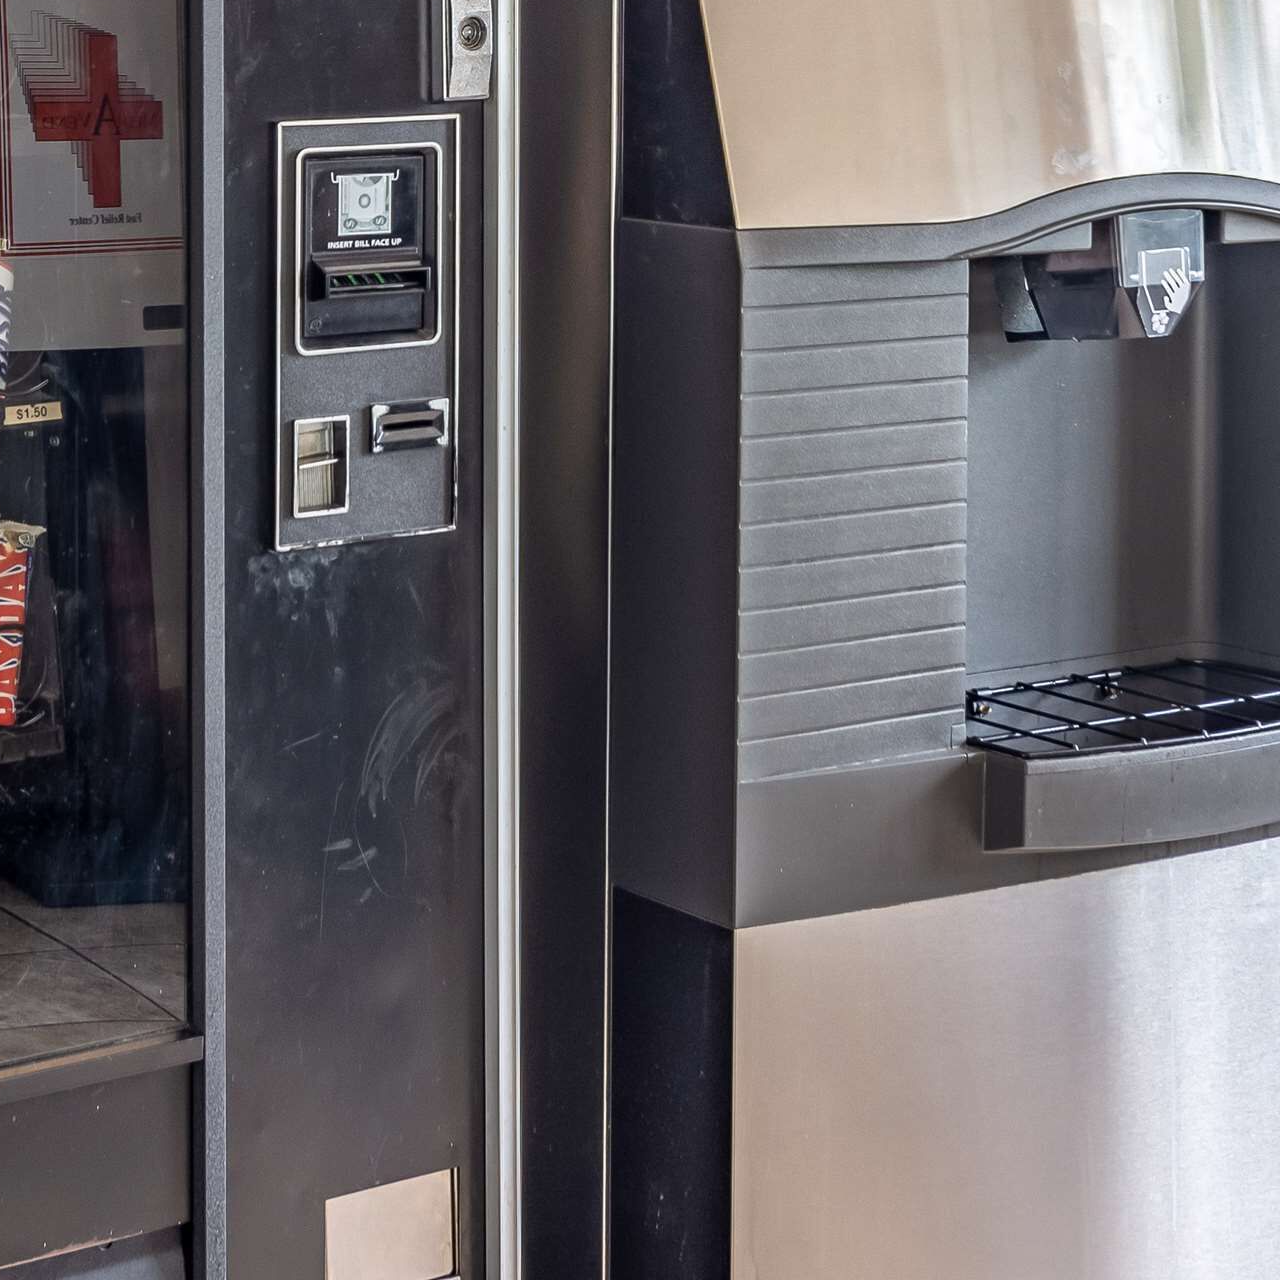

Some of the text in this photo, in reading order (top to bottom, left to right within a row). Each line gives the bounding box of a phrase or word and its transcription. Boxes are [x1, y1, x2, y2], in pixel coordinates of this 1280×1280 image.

[327, 237, 402, 249] INSERT BILL FACE UP
[16, 405, 48, 419] $1.50
